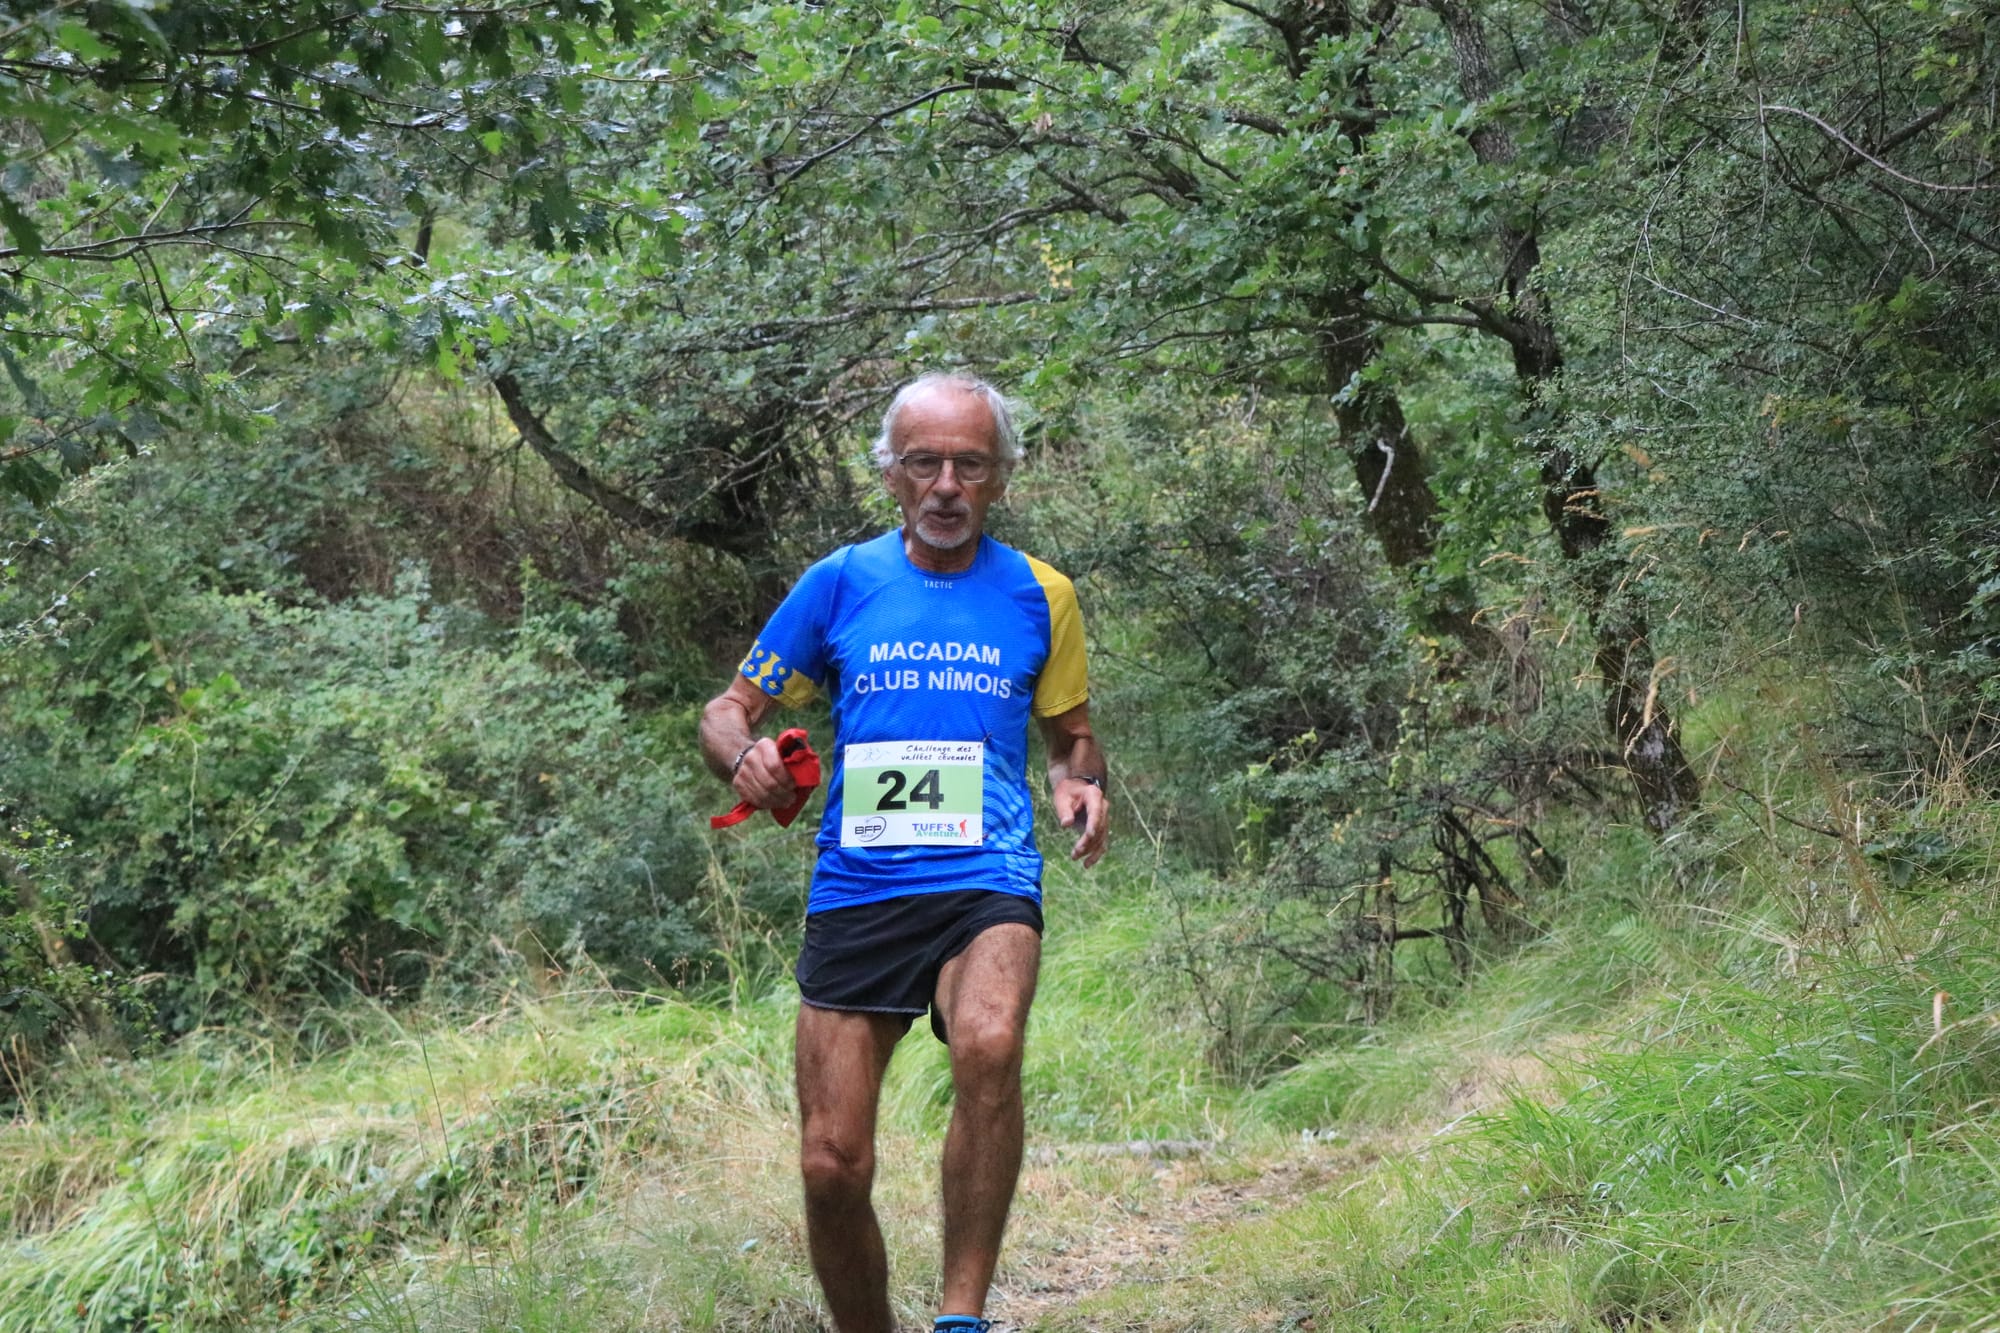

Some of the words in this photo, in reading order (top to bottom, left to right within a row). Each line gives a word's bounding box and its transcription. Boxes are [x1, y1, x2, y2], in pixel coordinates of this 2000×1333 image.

[924, 580, 953, 589] TACTIC
[869, 641, 1001, 666] MACADAM
[855, 669, 920, 694] CLUB
[927, 667, 1012, 699] NÎMOIS
[906, 745, 951, 754] Challenge
[957, 744, 972, 752] des
[876, 769, 944, 811] 24
[855, 825, 882, 835] BFP
[912, 823, 955, 832] TUFF'S
[915, 830, 960, 838] Aventure
